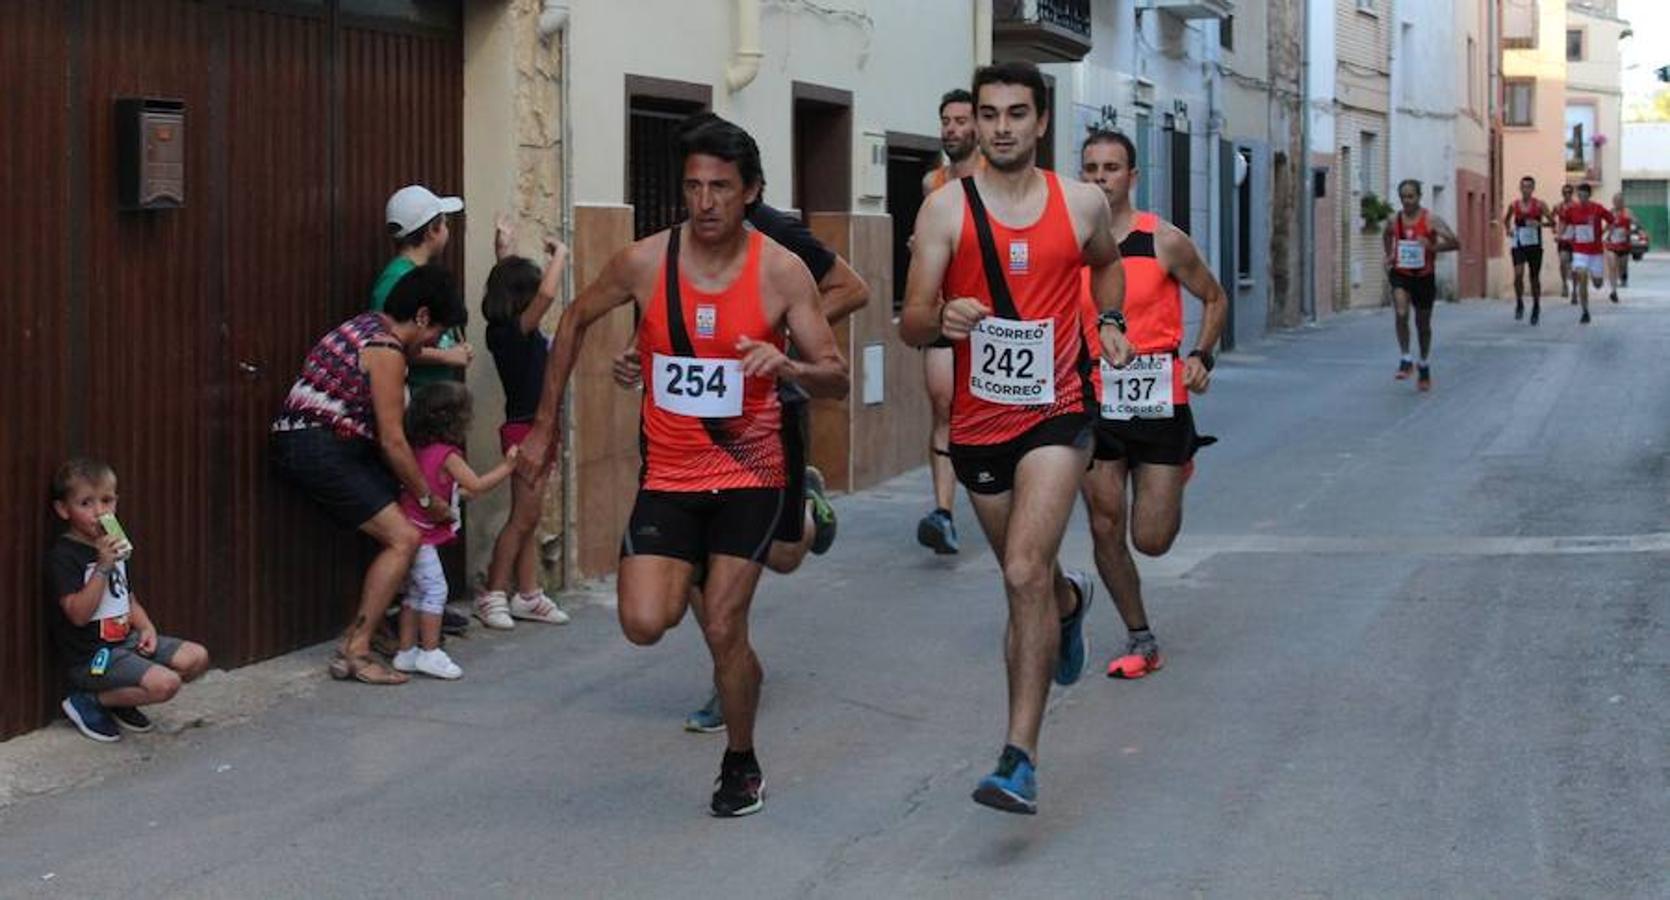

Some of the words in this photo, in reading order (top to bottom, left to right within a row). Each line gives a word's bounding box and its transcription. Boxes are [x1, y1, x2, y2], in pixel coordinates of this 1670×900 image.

[987, 324, 1044, 340] CORREO
[982, 343, 1034, 379] 242
[666, 363, 727, 398] 254
[971, 376, 983, 389] EL
[985, 381, 1042, 396] CORREO
[1114, 377, 1156, 401] 137
